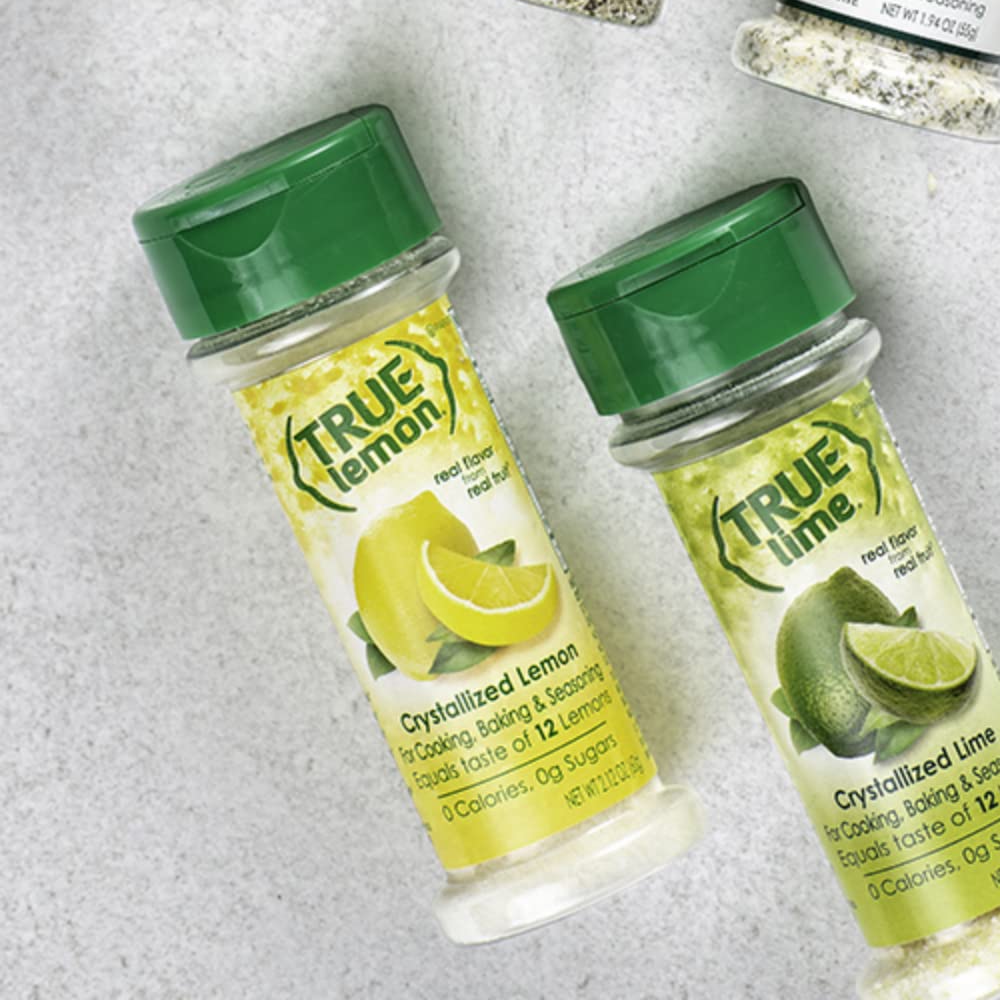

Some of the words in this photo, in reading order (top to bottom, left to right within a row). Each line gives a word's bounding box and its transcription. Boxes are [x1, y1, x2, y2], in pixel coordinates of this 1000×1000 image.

[880, 1, 901, 18] NET
[902, 7, 919, 22] WT
[920, 11, 941, 28] 1.94
[941, 16, 957, 34] OZ
[294, 354, 425, 466] TRUE
[327, 399, 443, 493] lemon
[433, 460, 463, 485] real
[462, 445, 495, 470] flavor
[467, 476, 493, 499] real
[720, 435, 851, 547] TRUE
[766, 491, 856, 567] lime
[861, 540, 889, 565] real
[888, 524, 918, 550] flavor
[893, 555, 919, 579] real
[400, 672, 515, 734] Crystallized
[516, 643, 579, 686] Lemon
[476, 704, 533, 738] Baking
[532, 695, 547, 713] &
[545, 663, 605, 707] Seasoning
[411, 763, 460, 793] Equals
[460, 745, 508, 775] taste
[512, 731, 533, 753] of
[534, 718, 558, 742] 12
[558, 689, 613, 731] Lemons
[441, 805, 454, 823] 0
[535, 763, 564, 786] 0g
[563, 733, 618, 772] Sugars
[834, 747, 953, 811] Crystallized
[953, 726, 997, 762] Lime
[564, 786, 586, 809] NET
[823, 824, 841, 843] For
[839, 809, 905, 842] Cooking,
[904, 784, 960, 818] Baking
[960, 774, 974, 793] &
[837, 840, 891, 870] Equals
[893, 820, 946, 851] taste
[951, 801, 973, 827] of
[974, 790, 1000, 814] 12
[867, 882, 881, 901] 0
[961, 842, 990, 866] 0g
